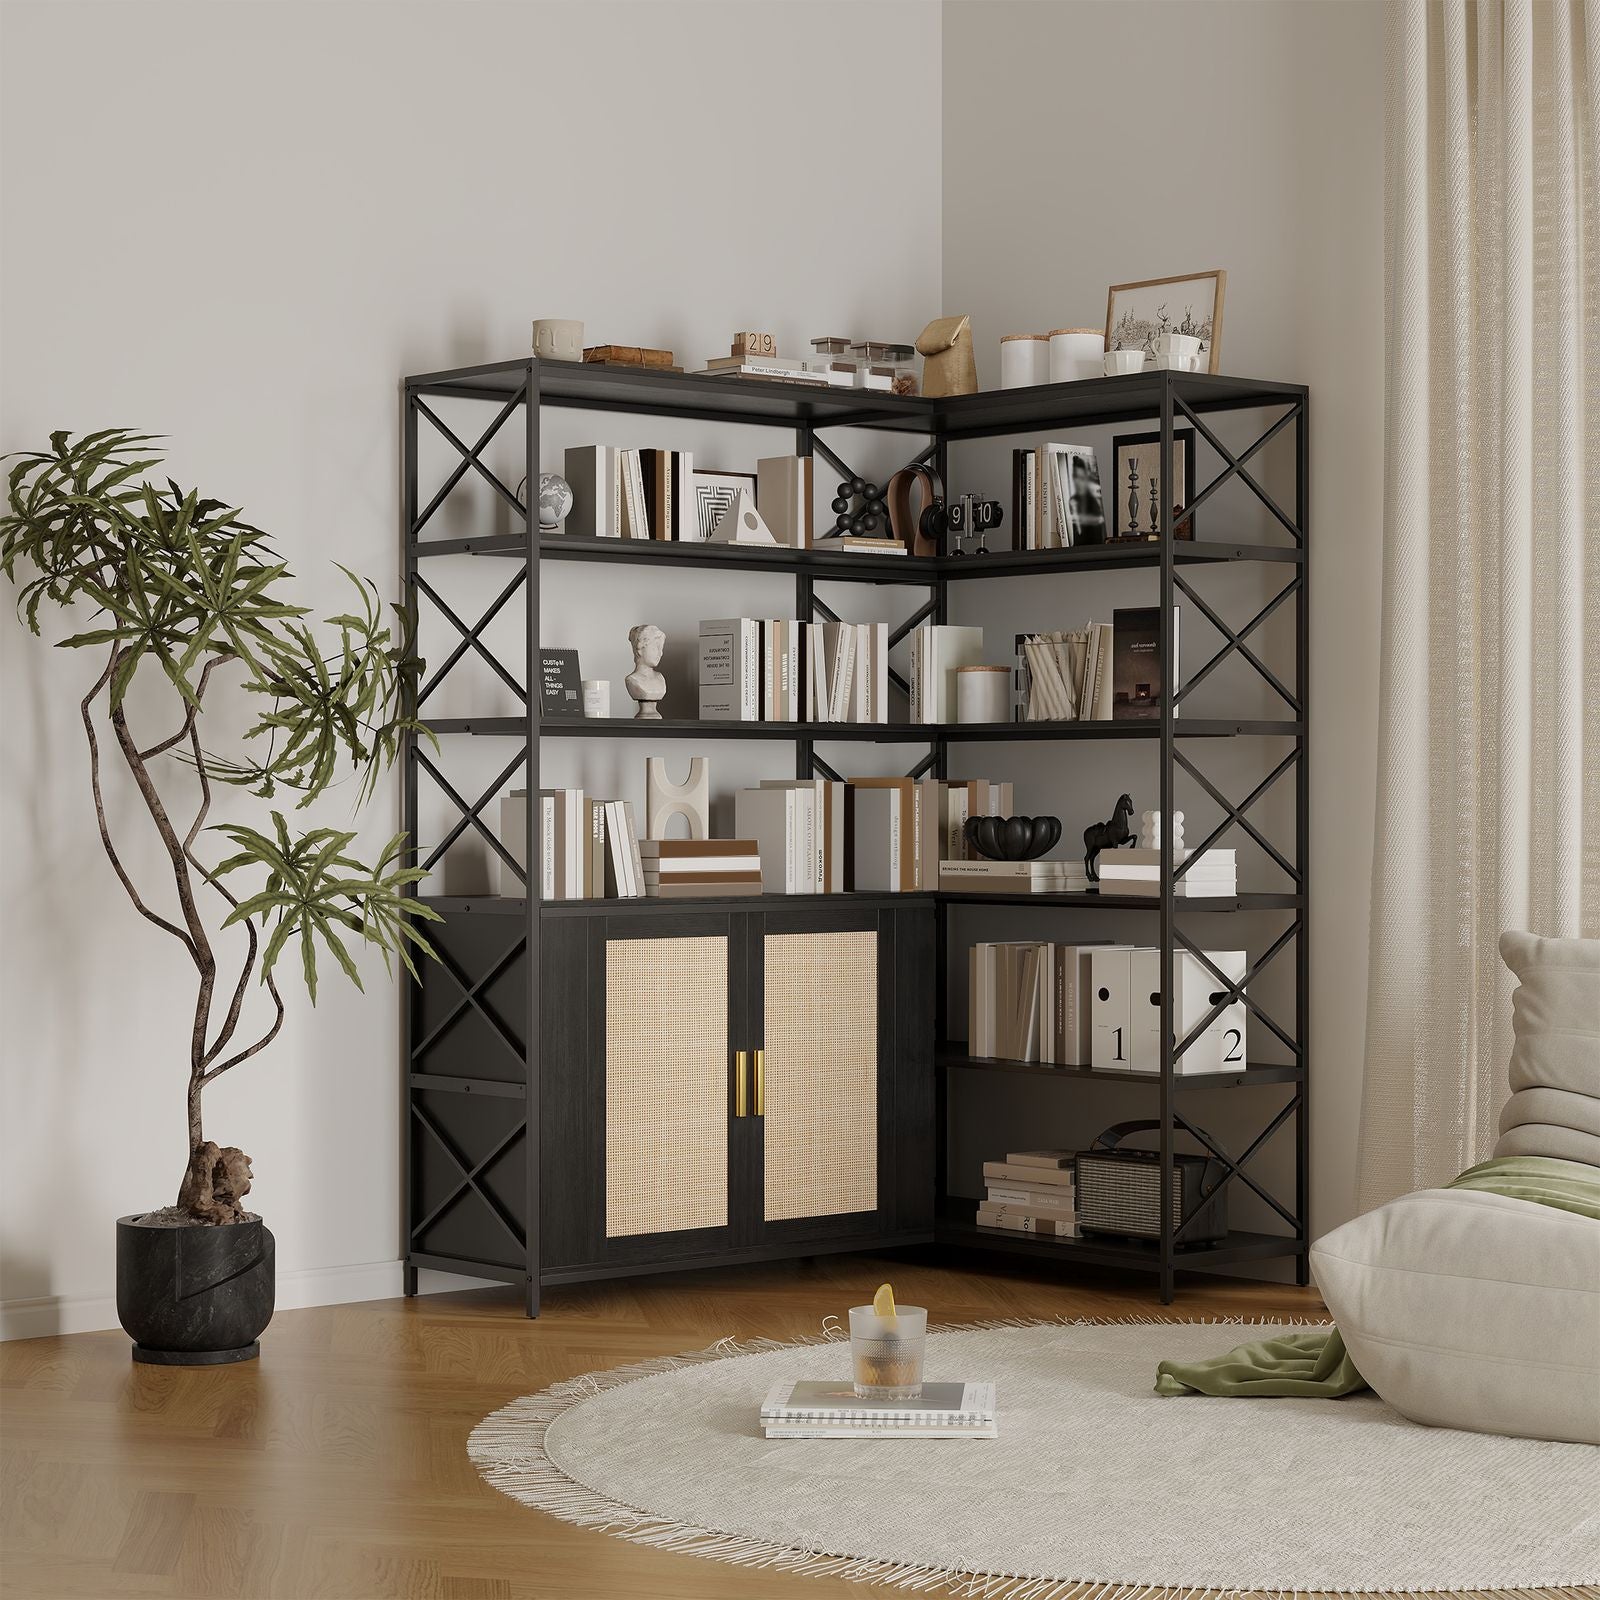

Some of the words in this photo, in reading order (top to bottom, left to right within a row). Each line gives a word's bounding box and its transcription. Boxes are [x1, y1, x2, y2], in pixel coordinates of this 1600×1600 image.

[751, 366, 765, 374] Peter
[765, 368, 790, 377] Lindbergh
[952, 506, 961, 525] 9
[977, 502, 992, 523] 10
[1112, 1026, 1127, 1061] 1
[1223, 1028, 1243, 1062] 2
